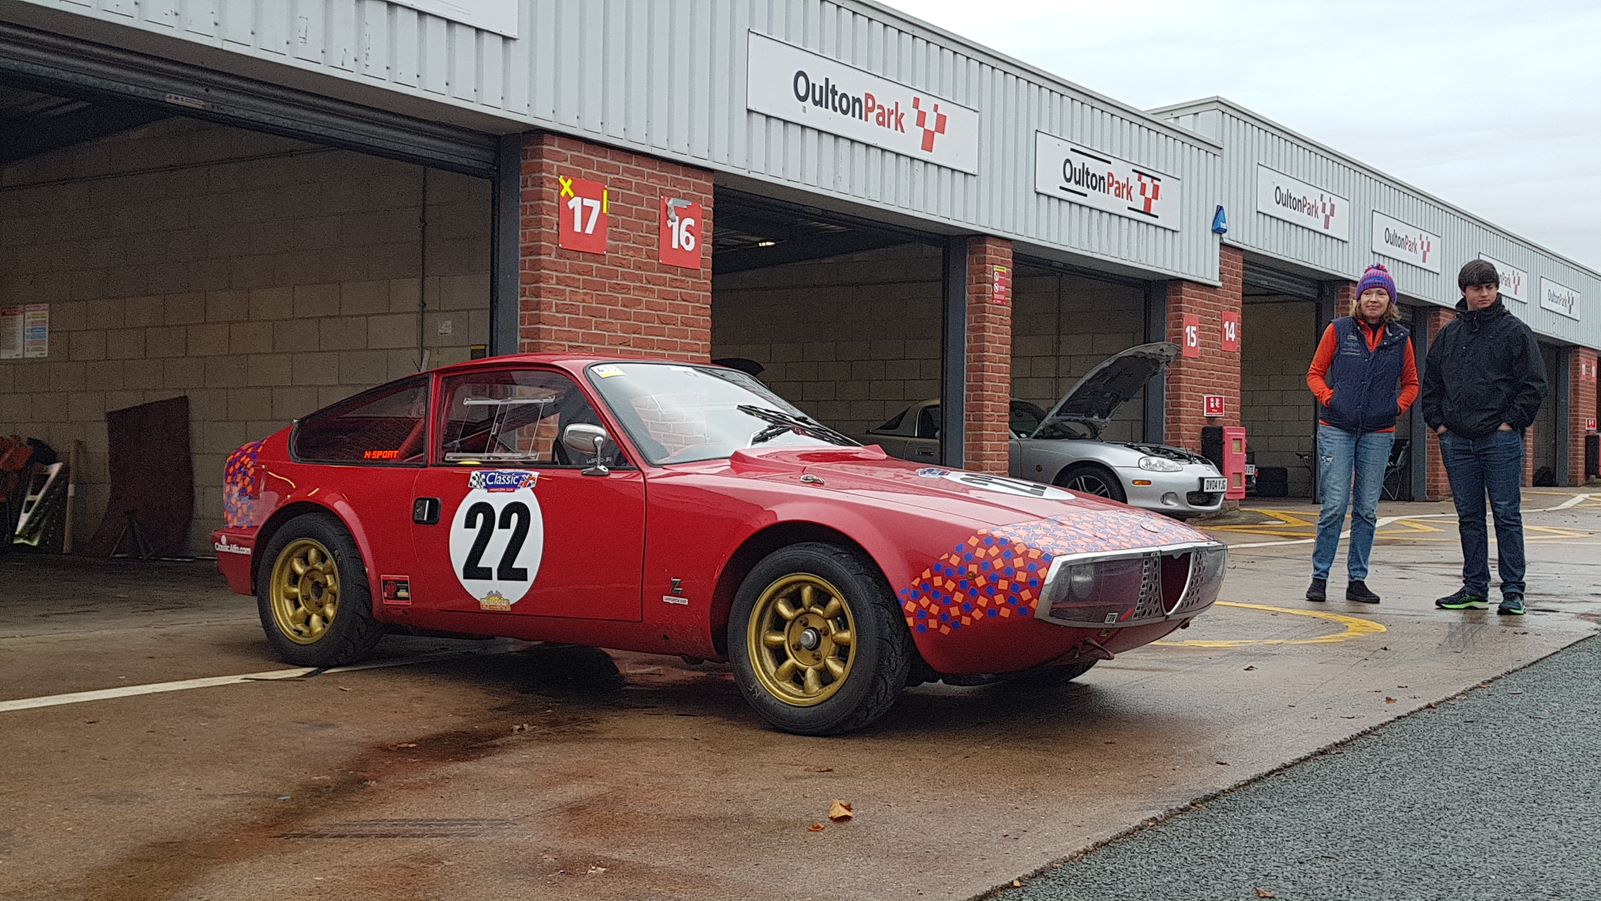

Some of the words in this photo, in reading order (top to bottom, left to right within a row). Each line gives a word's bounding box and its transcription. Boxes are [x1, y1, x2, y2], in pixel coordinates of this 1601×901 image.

[567, 196, 601, 235] 17
[666, 216, 696, 252] 16
[1185, 325, 1197, 348] 15
[1224, 320, 1236, 342] 14
[486, 472, 520, 485] Classic
[462, 501, 532, 582] 22
